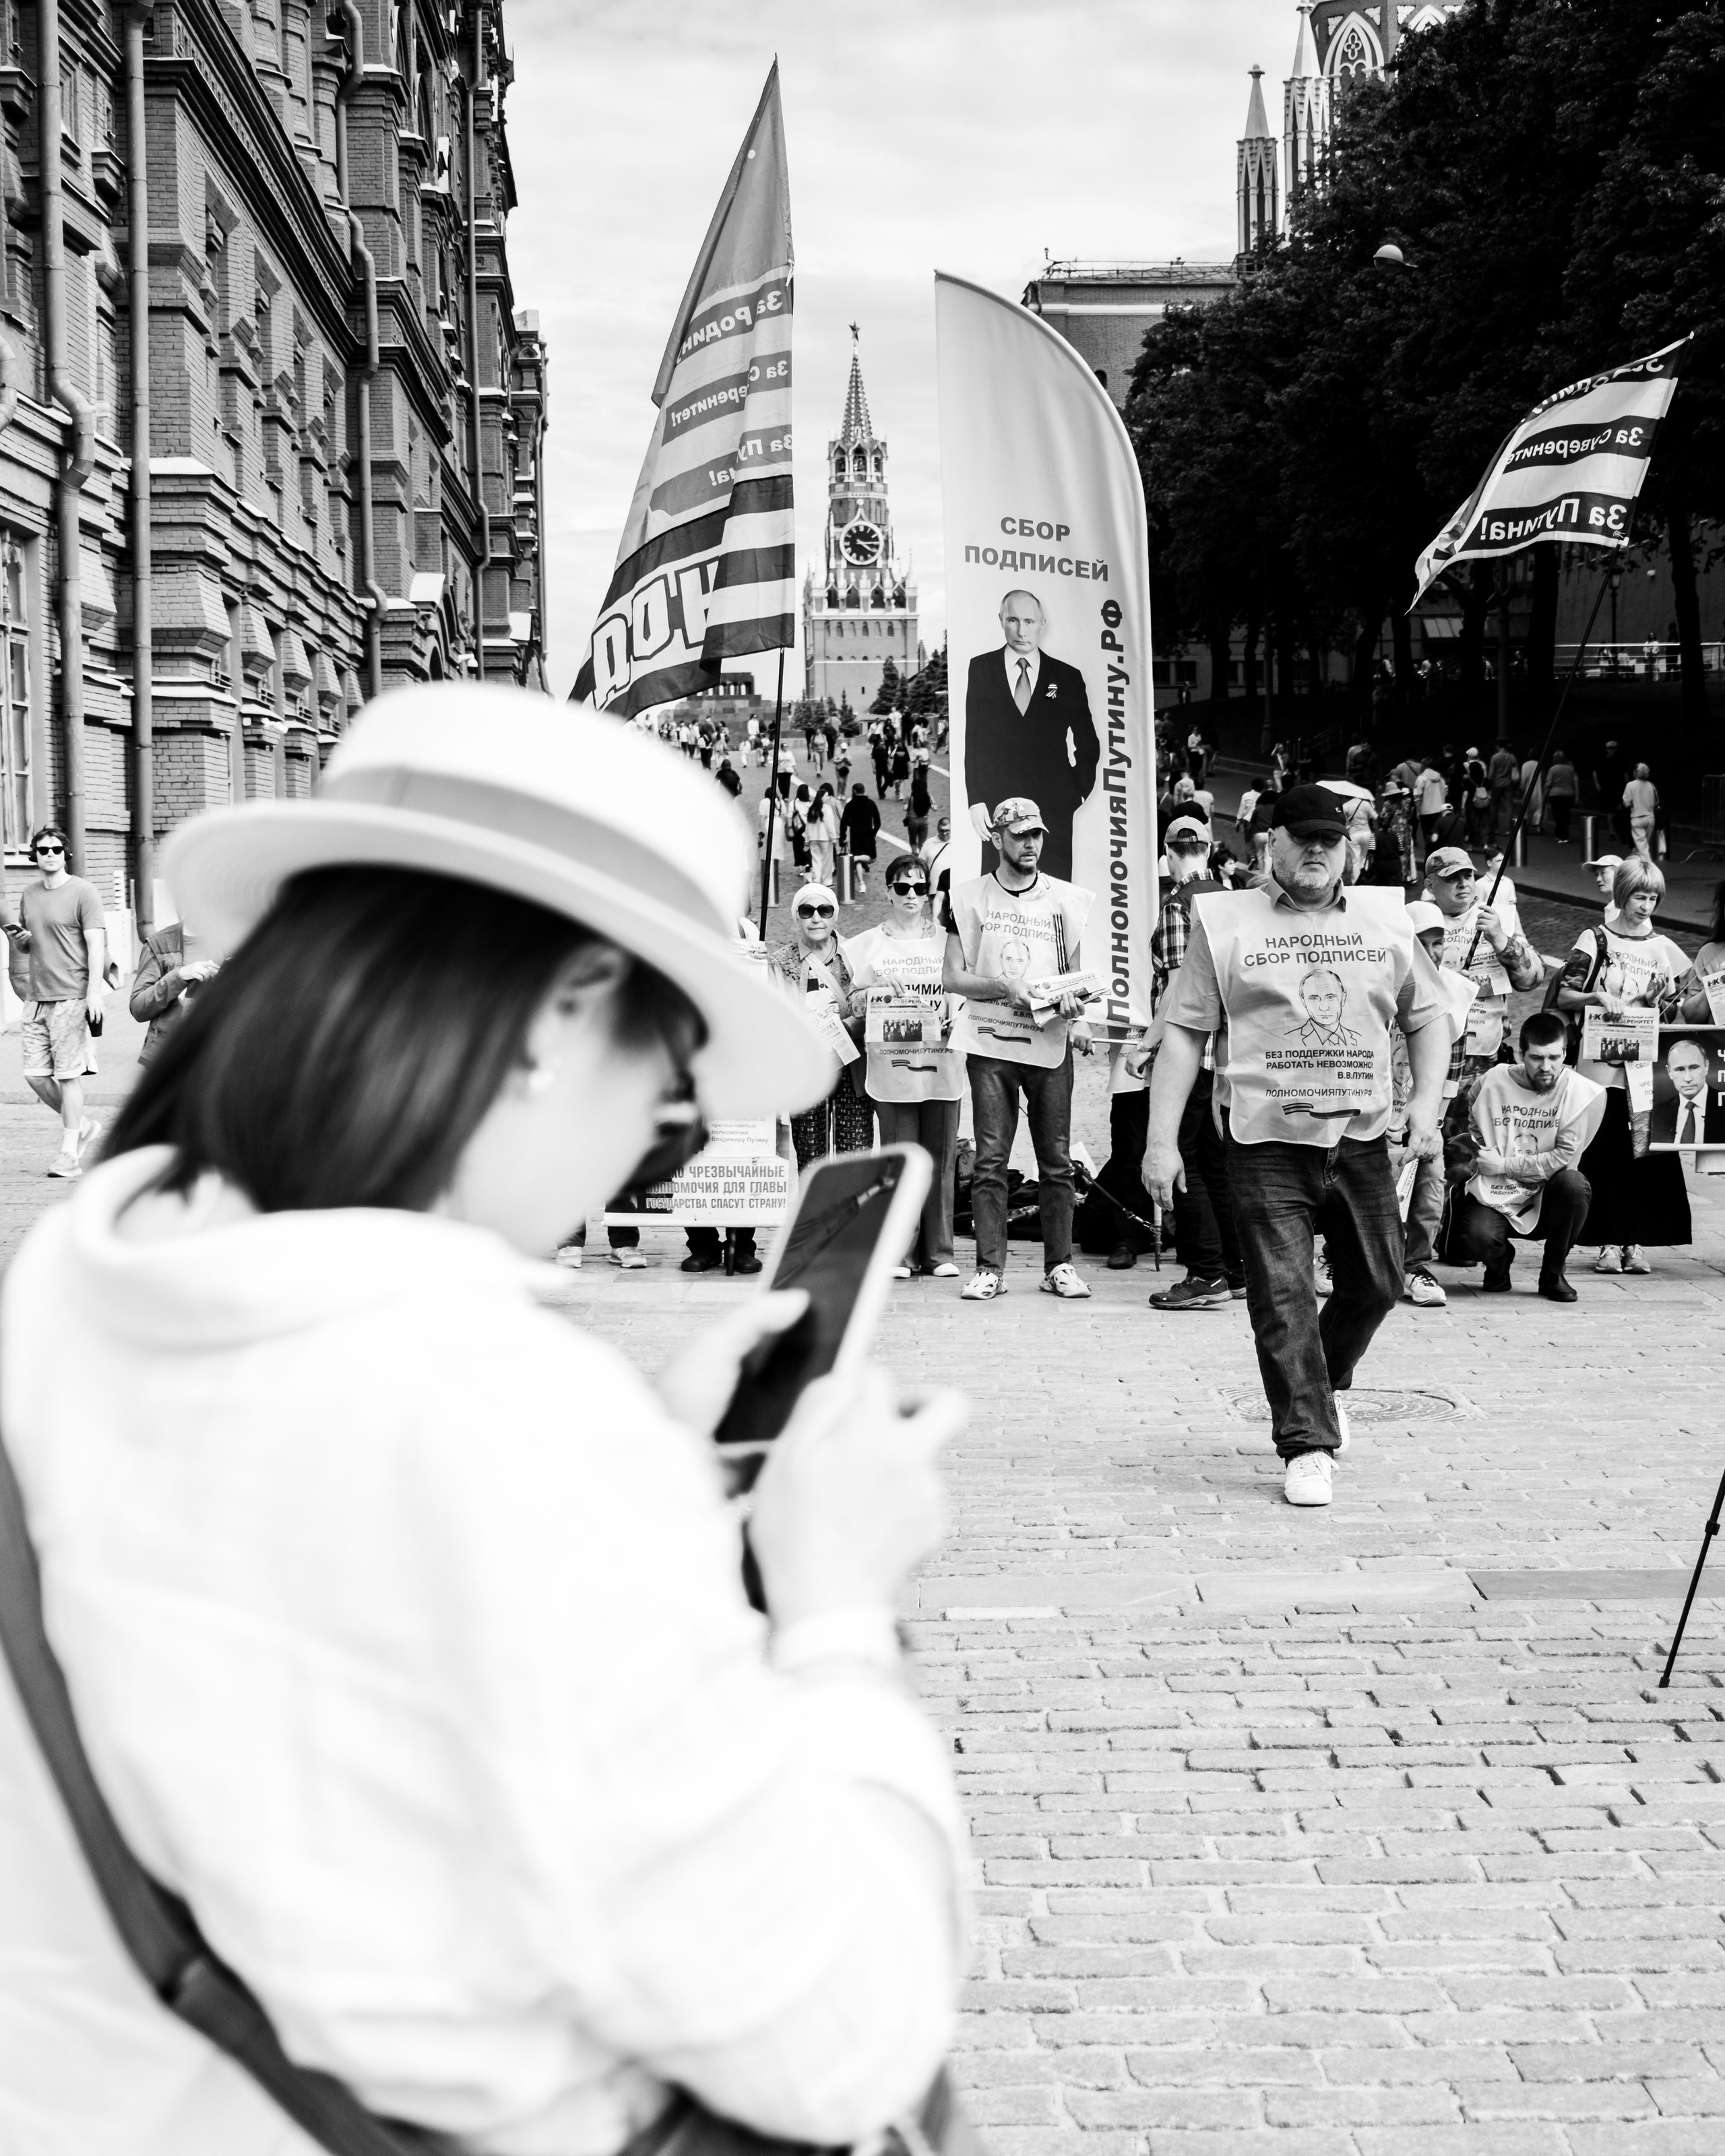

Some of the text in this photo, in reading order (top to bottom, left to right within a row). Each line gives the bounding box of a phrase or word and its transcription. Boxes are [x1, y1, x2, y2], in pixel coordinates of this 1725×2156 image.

[1001, 517, 1070, 542] СБОР
[965, 545, 1108, 582] ПОДПИСЕЙ
[986, 910, 1051, 929] НАРОДНЫЙ
[1004, 924, 1057, 943] ПОДПИСЕ
[1265, 932, 1363, 949] НАРОДНЫЙ
[1244, 947, 1386, 967] СБОР ПОДПИСЕЙ
[876, 966, 942, 977] БОР ПОДПИ
[1265, 1049, 1374, 1059] БЕЗ ПОДДЕРЖКИ НАРОДА
[1266, 1060, 1373, 1069] РАБОТАТЬ НЕВОЗМОЖНО!
[1635, 1061, 1650, 1069] СБОР
[1338, 1071, 1373, 1080] В.В.ПУТИН
[1501, 1105, 1559, 1118] НАРОДНЫЙ
[689, 1166, 784, 1178] ЧРЕЗВЫЧАЙНЫЕ
[724, 1182, 745, 1195] ДЛЯ
[750, 1181, 787, 1193] ГЛАВЫ
[646, 1197, 786, 1210] ГОСУДАРСТВА СПАСУТ СТРАНУ!
